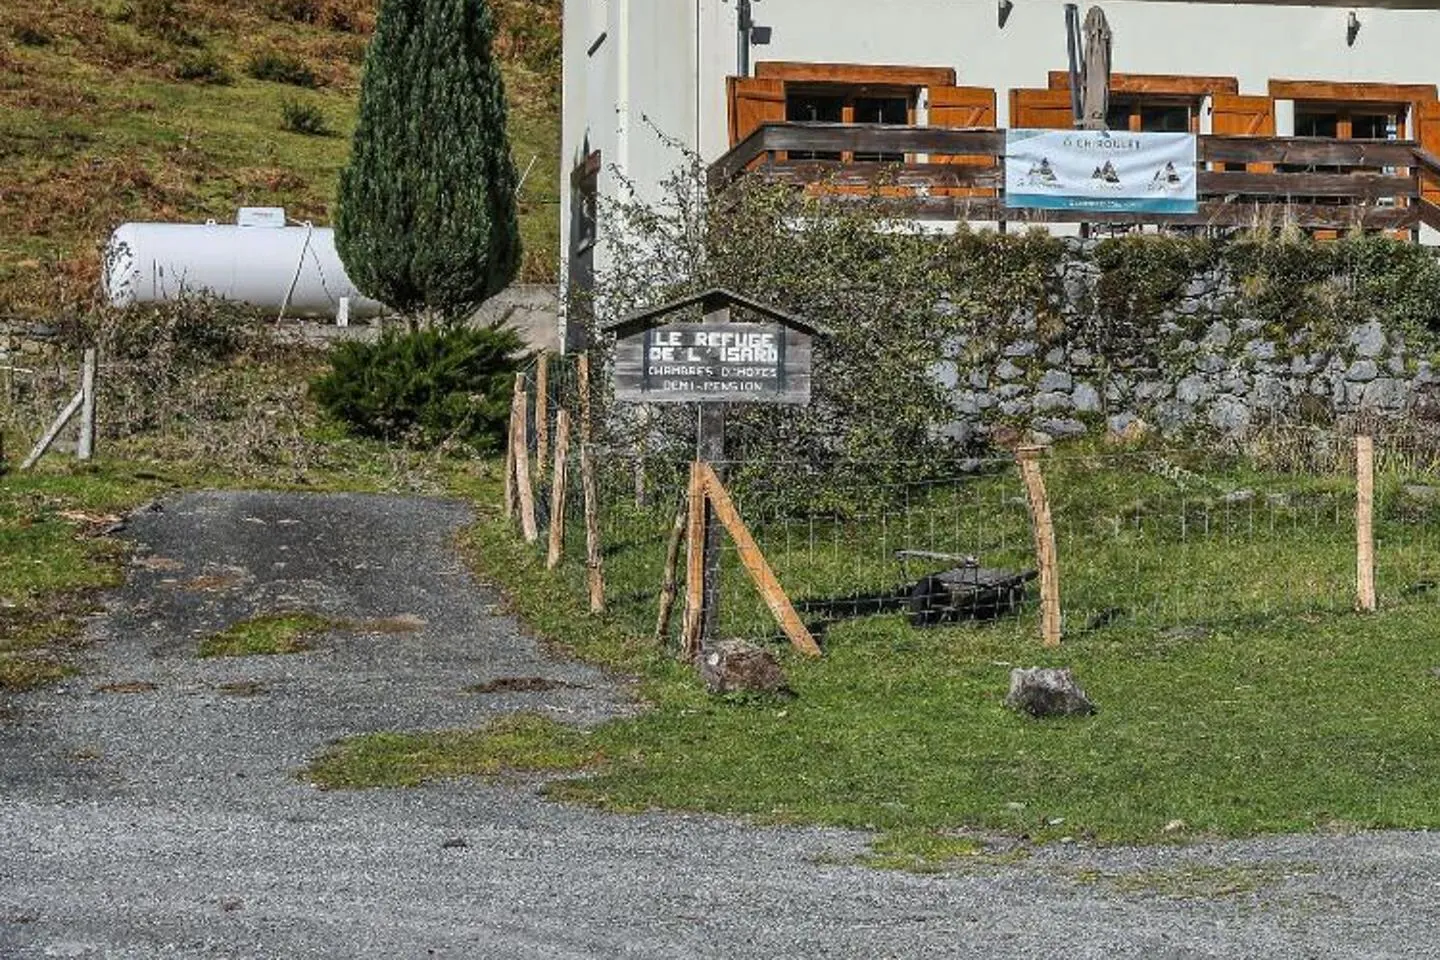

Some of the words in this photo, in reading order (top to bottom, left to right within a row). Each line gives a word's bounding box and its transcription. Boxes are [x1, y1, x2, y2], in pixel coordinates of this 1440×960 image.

[656, 331, 683, 347] LE
[694, 331, 775, 348] REFUGE
[649, 346, 675, 362] DE
[648, 365, 714, 377] CHAMBRES
